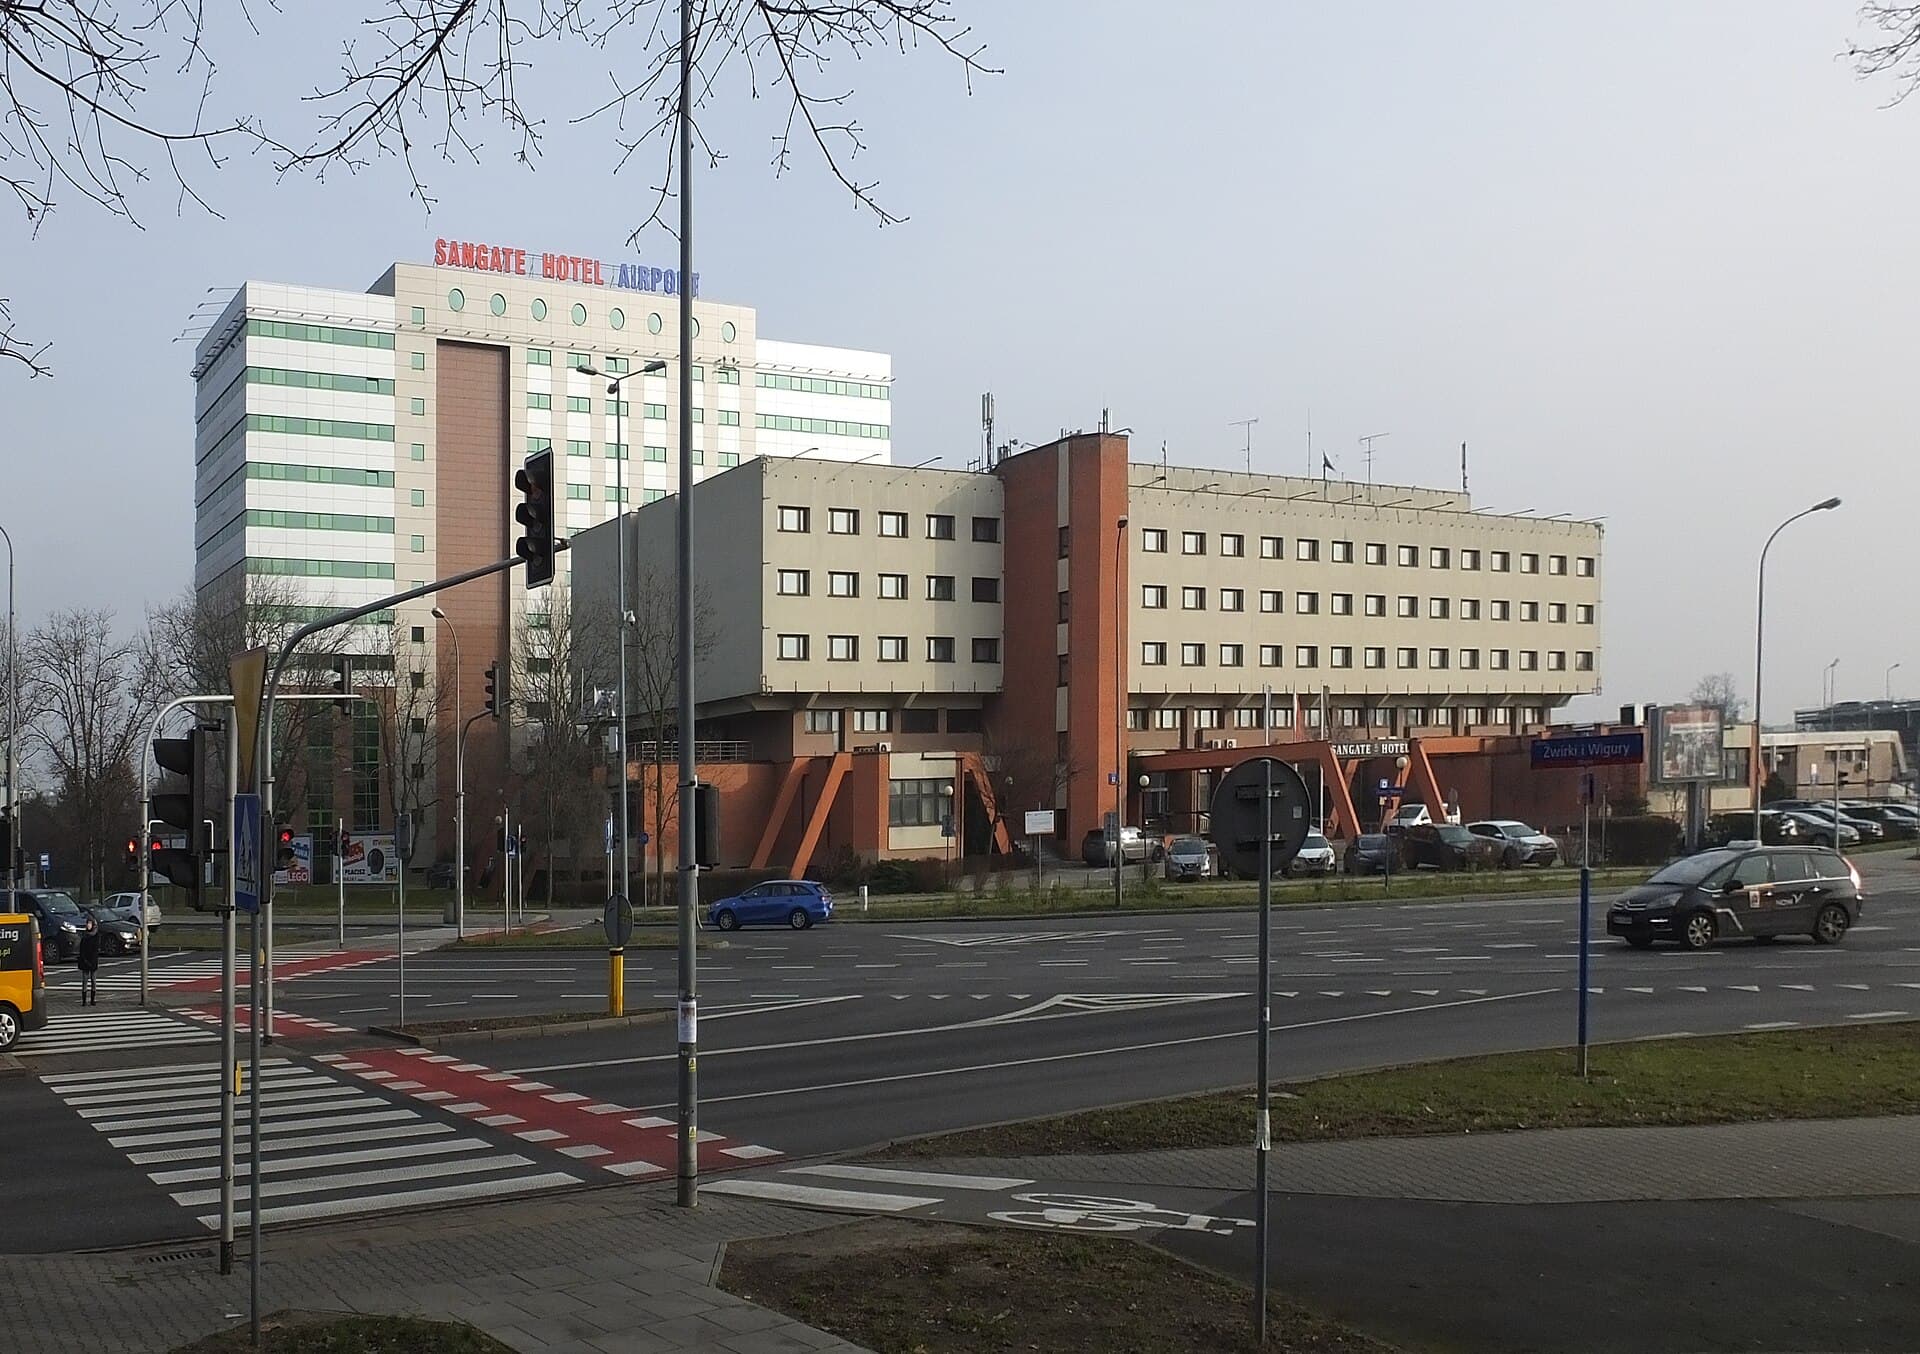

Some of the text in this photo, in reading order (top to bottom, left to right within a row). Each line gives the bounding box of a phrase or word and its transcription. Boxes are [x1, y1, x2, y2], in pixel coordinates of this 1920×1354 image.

[434, 238, 700, 297] SANGATE HOTEL AIRPOT
[1331, 743, 1410, 755] SANGATE HOTEL
[1581, 744, 1585, 756] i
[1588, 743, 1630, 758] Wigury
[288, 872, 308, 882] LEGO
